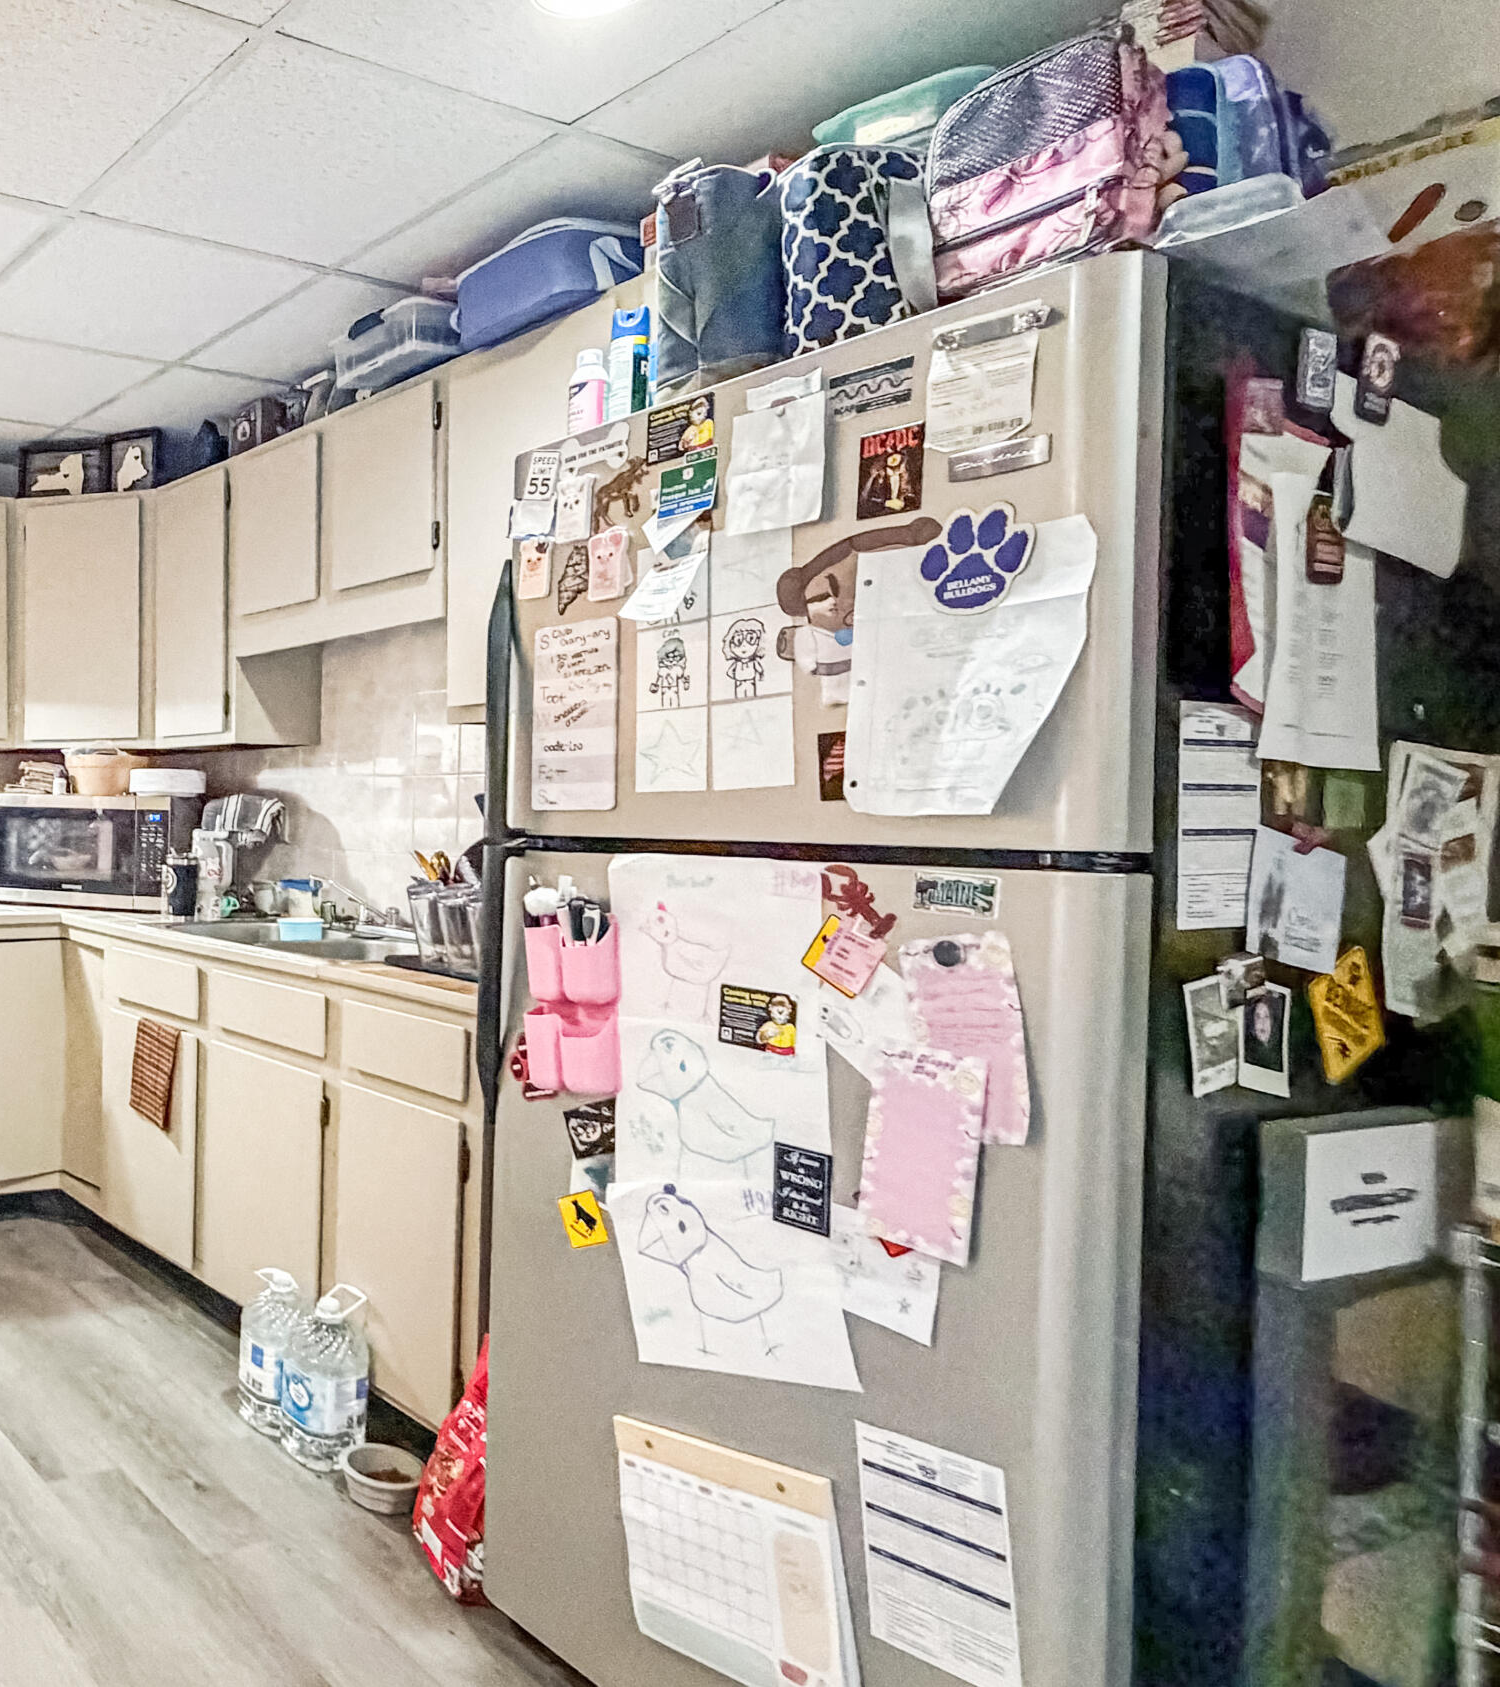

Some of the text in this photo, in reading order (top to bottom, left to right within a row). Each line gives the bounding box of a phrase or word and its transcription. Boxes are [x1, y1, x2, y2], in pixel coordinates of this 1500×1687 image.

[532, 456, 557, 466] SPEED
[532, 467, 553, 476] LIMIT
[527, 477, 551, 496] 55
[943, 582, 997, 600] BULLDOGS
[946, 574, 993, 591] BELLAMY
[778, 1169, 823, 1191] WRONG
